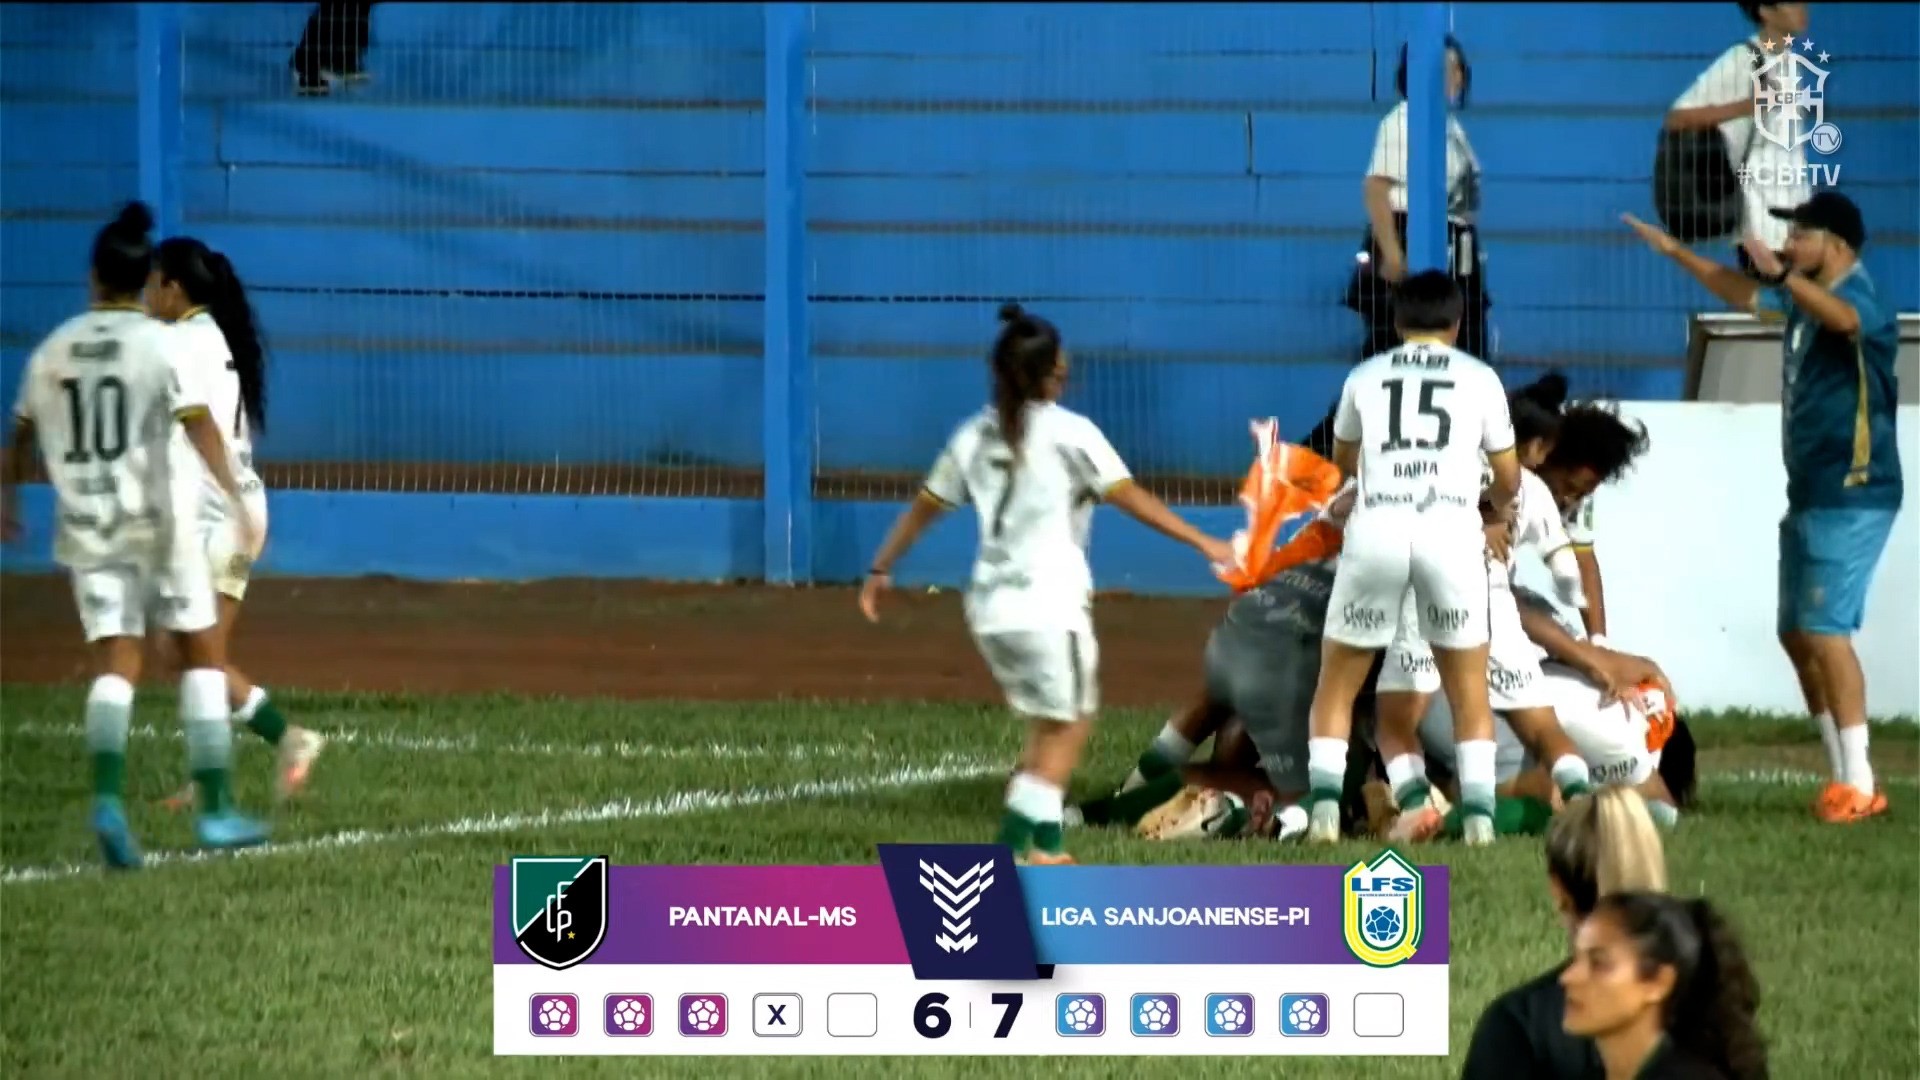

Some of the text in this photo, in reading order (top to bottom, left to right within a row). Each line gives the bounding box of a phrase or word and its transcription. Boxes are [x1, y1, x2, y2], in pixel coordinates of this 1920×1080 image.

[1391, 352, 1450, 370] EULER
[60, 374, 128, 463] 10
[1380, 377, 1456, 454] 15
